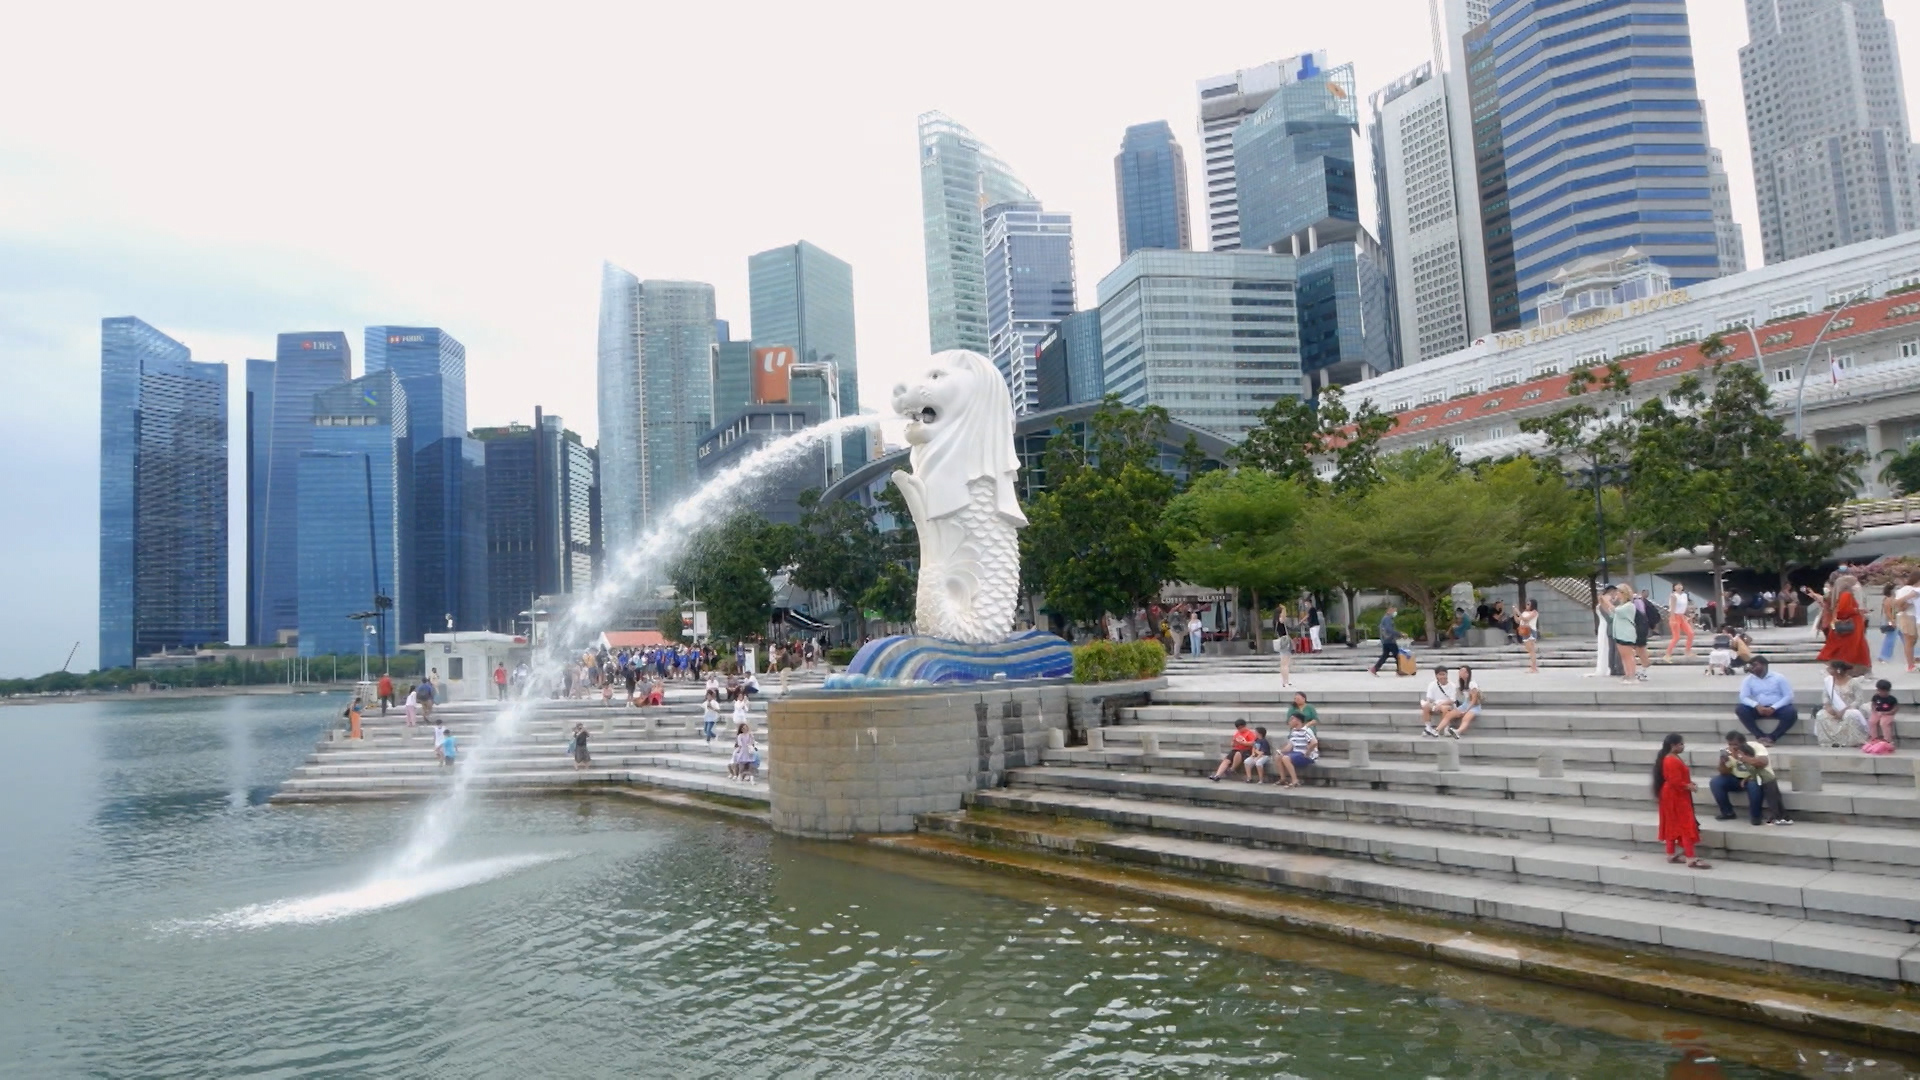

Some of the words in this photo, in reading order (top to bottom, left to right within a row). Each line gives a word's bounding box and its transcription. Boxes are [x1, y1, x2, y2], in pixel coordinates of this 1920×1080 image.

[1496, 332, 1525, 349] THE
[1530, 306, 1623, 341] FULLERTON
[1629, 288, 1689, 316] HOTEL
